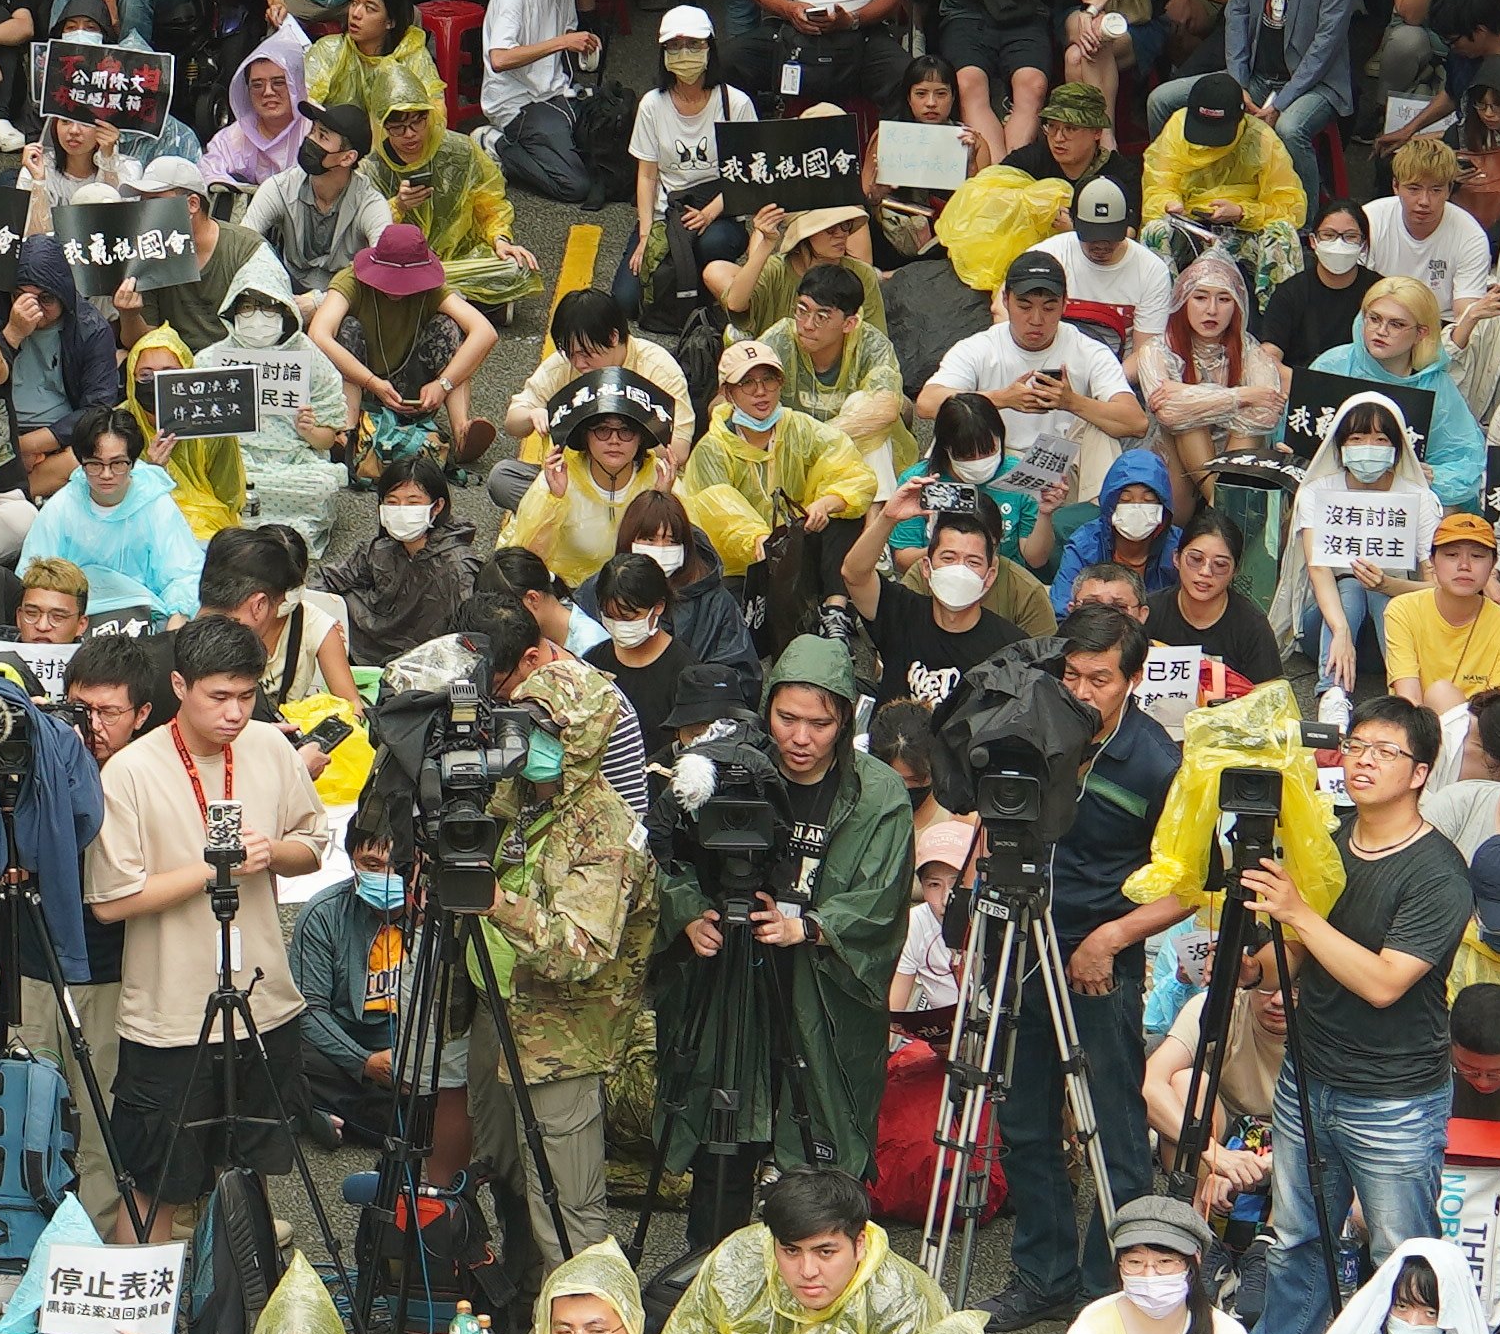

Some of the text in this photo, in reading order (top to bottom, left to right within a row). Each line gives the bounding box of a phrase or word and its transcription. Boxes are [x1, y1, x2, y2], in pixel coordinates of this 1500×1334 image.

[720, 148, 859, 184] 我藐視國會
[64, 230, 195, 265] 我藐視國會
[1326, 505, 1407, 527] 沒有討論
[1325, 535, 1404, 557] 沒有民主
[51, 1267, 174, 1300] 停止表決
